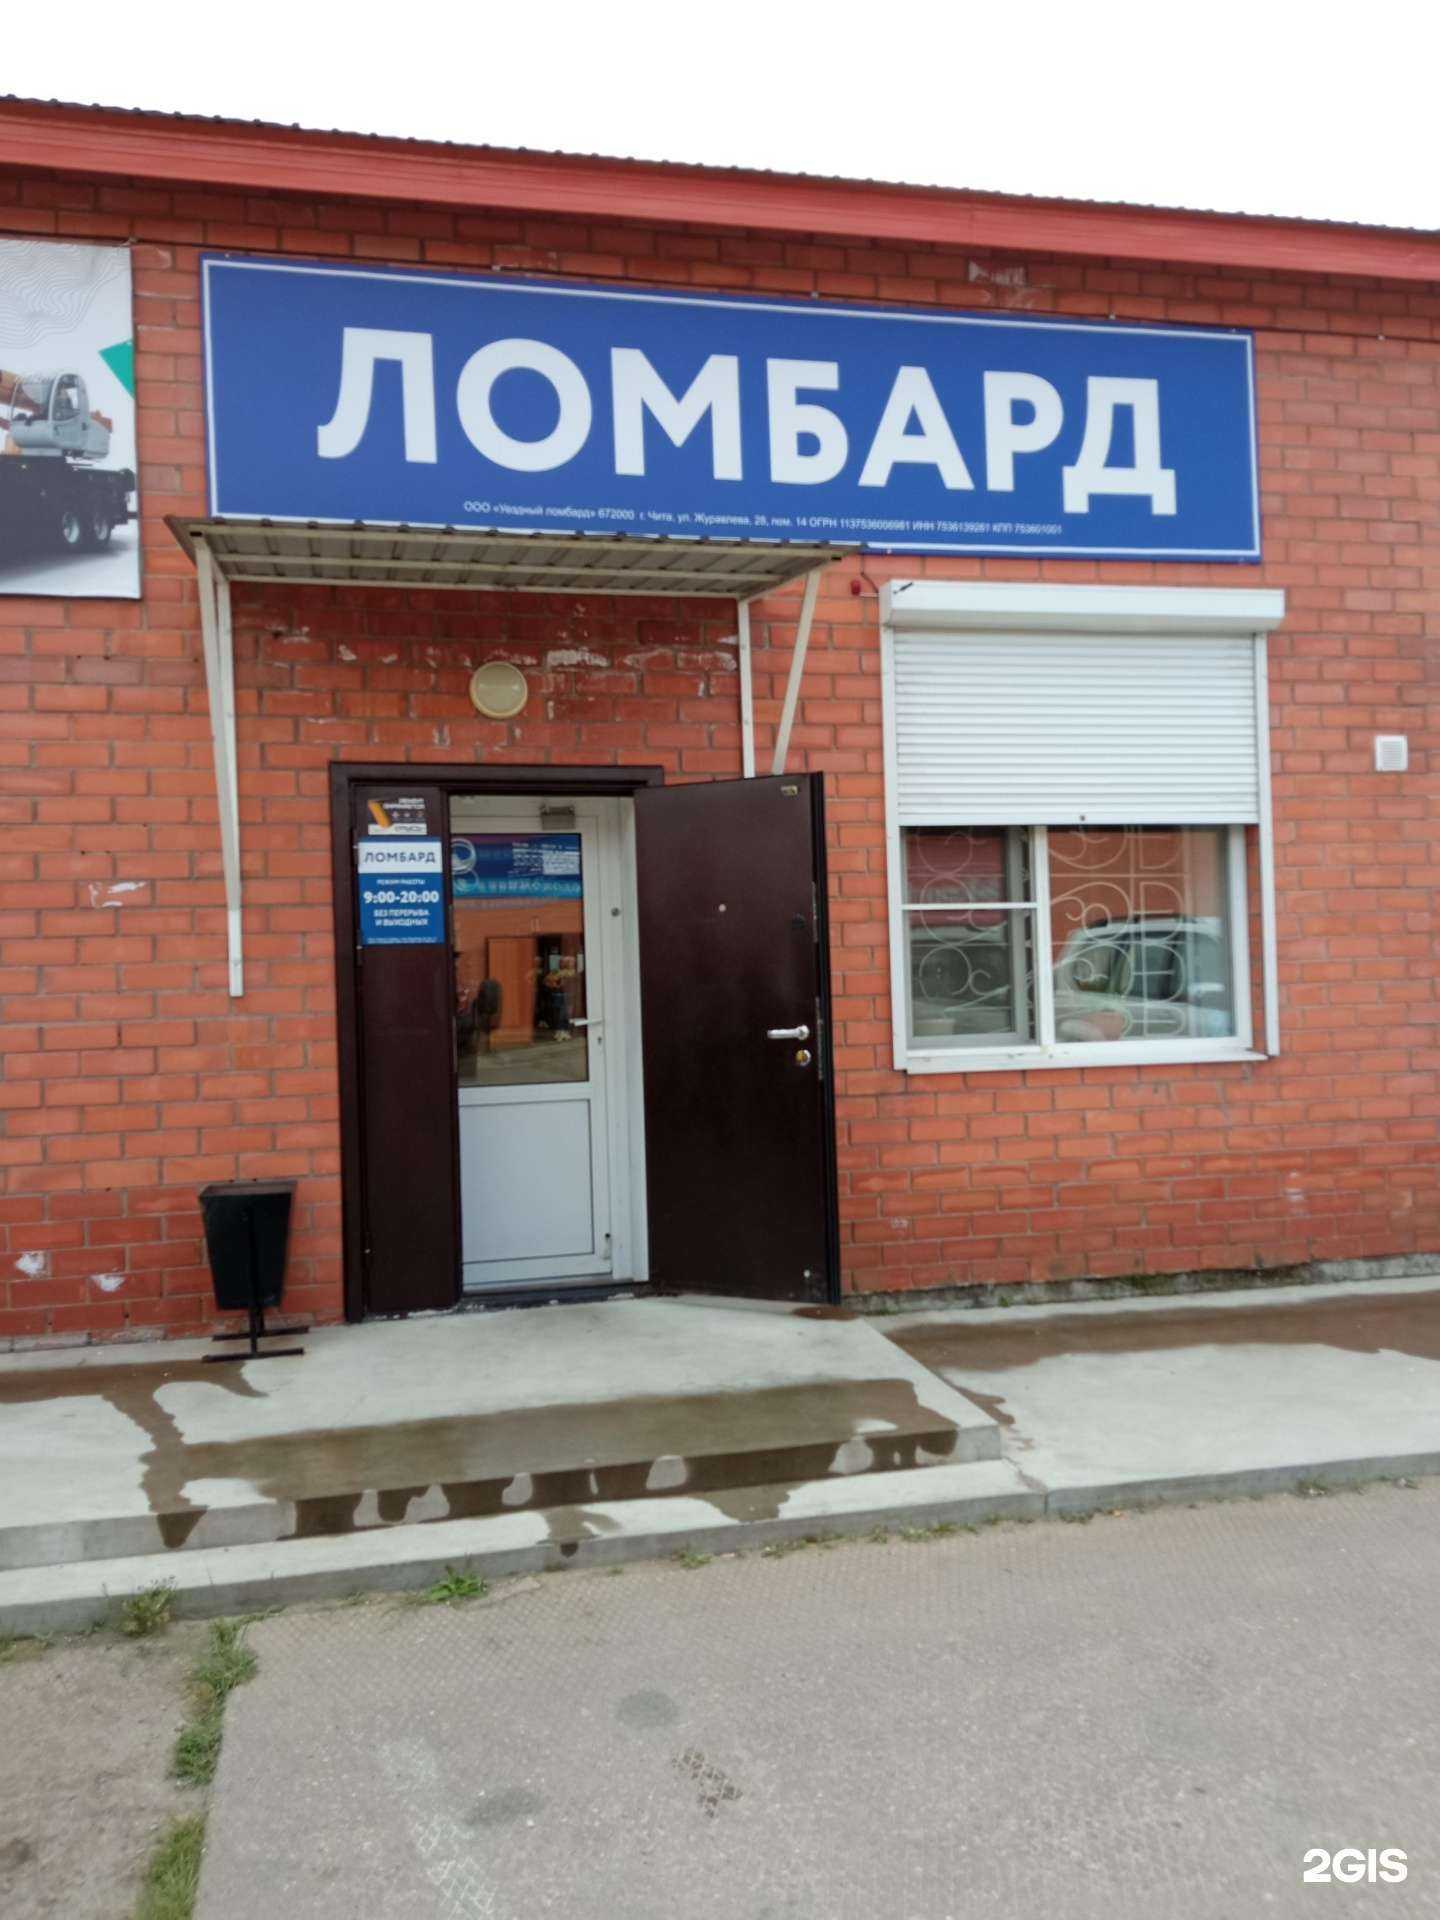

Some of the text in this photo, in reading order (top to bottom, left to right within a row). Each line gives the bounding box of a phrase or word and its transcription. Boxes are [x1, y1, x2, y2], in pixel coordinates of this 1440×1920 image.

[316, 326, 1178, 516] ЛОМБАРД
[463, 500, 491, 514] ООО
[597, 507, 635, 521] 672000
[796, 516, 807, 527] 14
[809, 516, 837, 529] ОГРН
[912, 519, 935, 532] ИНН
[364, 851, 437, 864] ЛОМБАРД
[363, 890, 440, 904] 9:00-20:00
